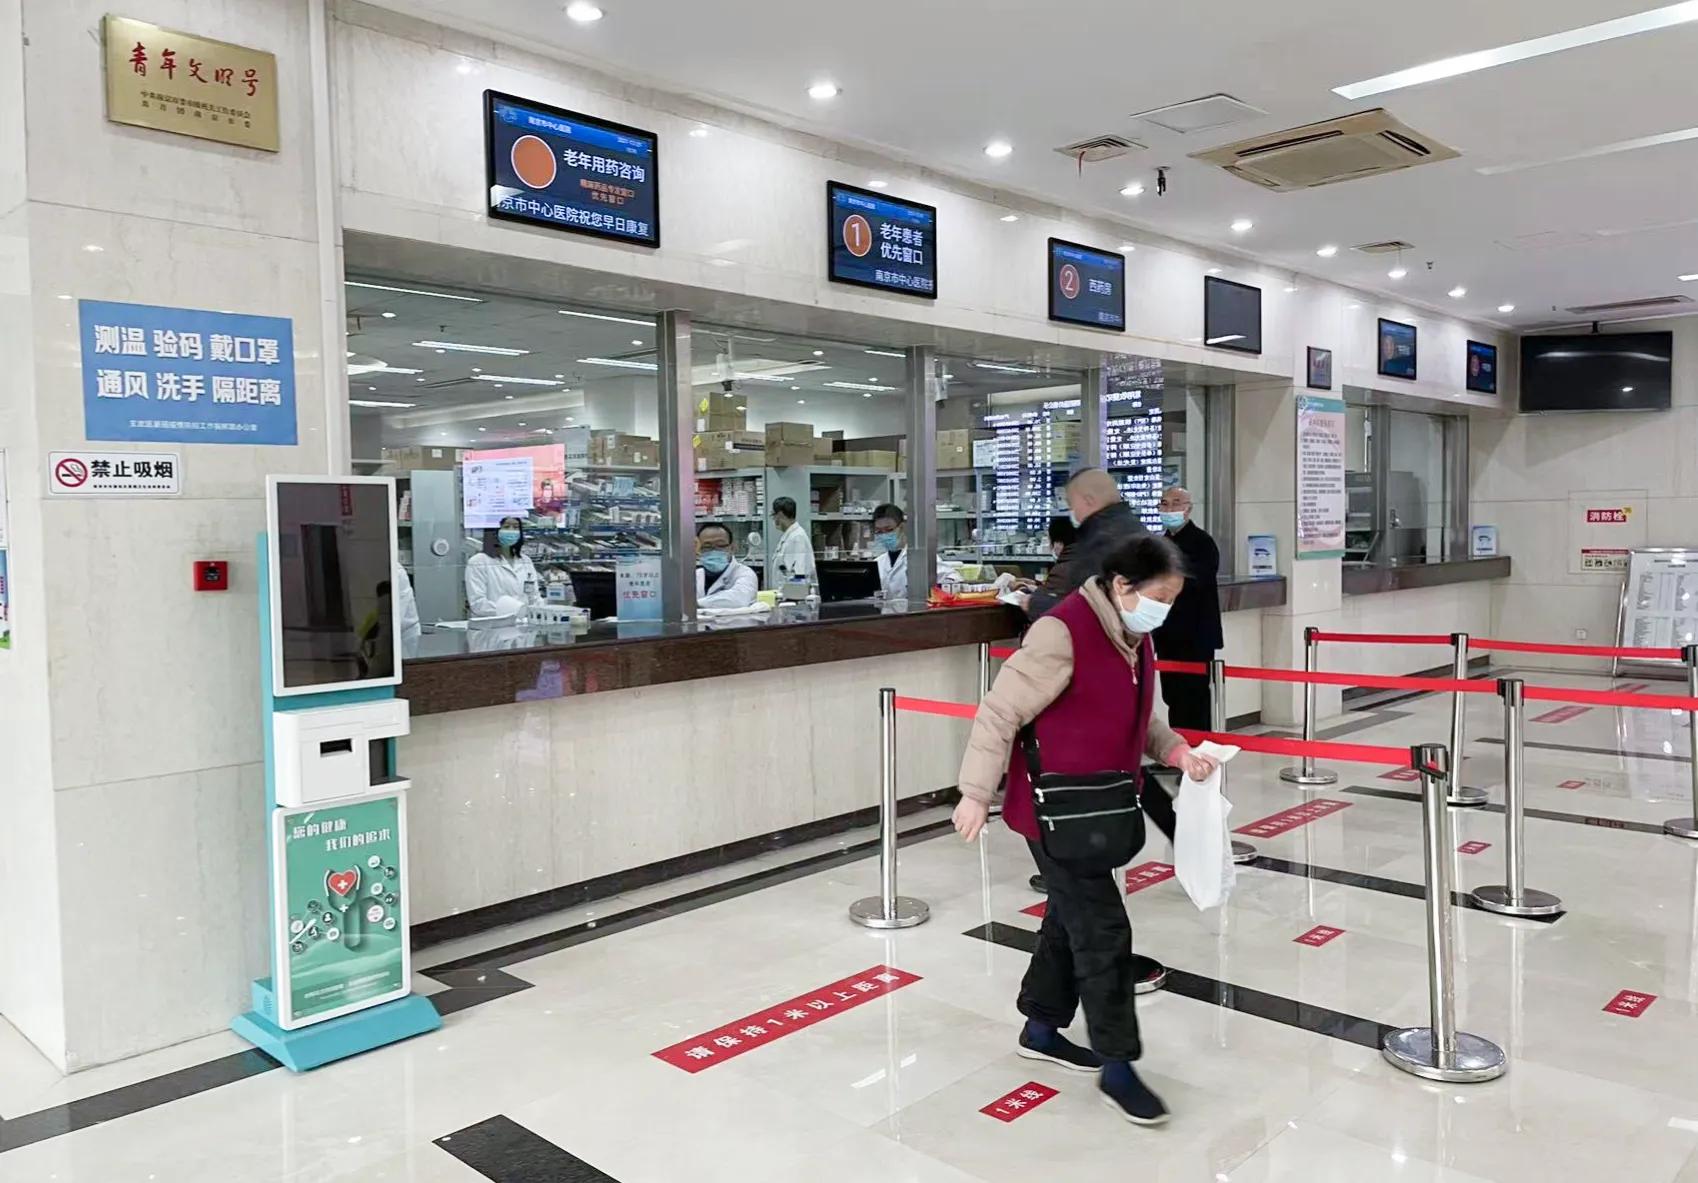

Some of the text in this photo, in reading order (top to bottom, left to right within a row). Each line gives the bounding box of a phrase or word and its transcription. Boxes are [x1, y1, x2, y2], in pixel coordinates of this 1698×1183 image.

[129, 41, 259, 97] 青年文明号
[563, 149, 645, 182] 老年用药咨询
[851, 222, 860, 247] 1
[880, 222, 923, 247] 老年患者
[880, 241, 923, 265] 优先窗口
[1065, 270, 1074, 291] 2
[94, 325, 280, 366] 测温 验码 戴口罩
[97, 369, 281, 406] 通风 洗手 隔距离
[91, 460, 173, 478] 禁止吸烟
[685, 971, 901, 1061] 请保持1米以上距离
[996, 1089, 1045, 1116] 1米线
